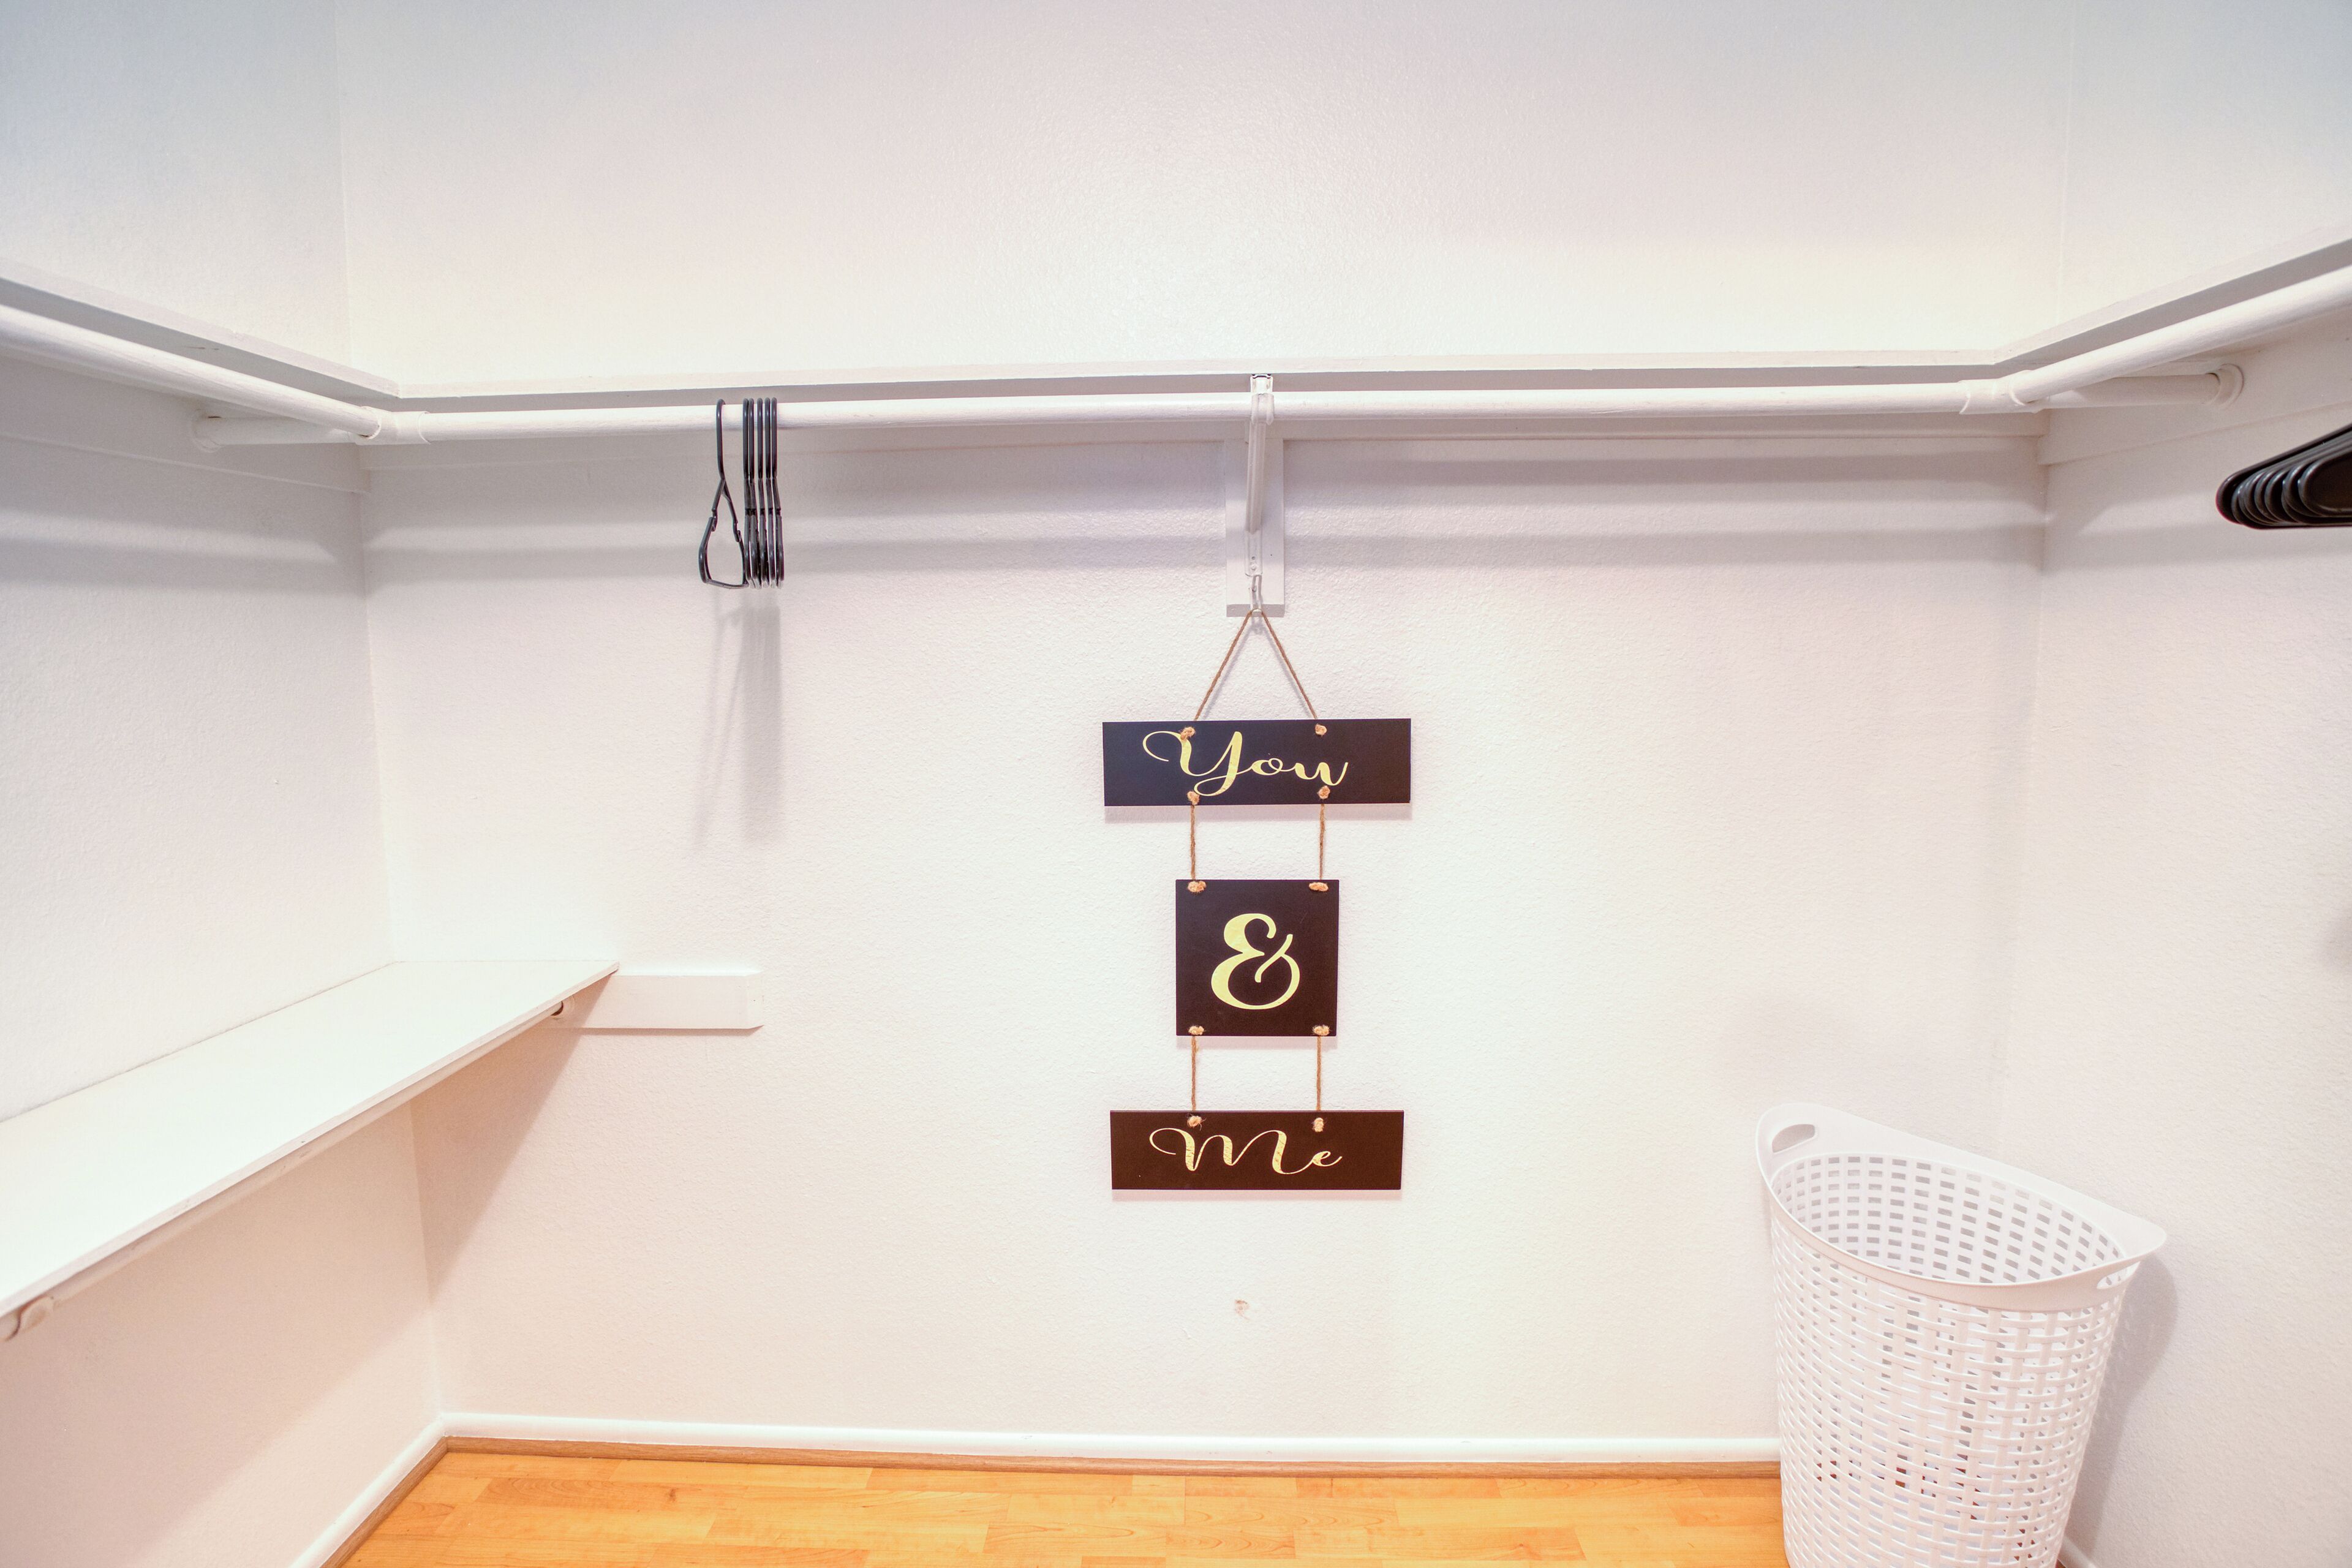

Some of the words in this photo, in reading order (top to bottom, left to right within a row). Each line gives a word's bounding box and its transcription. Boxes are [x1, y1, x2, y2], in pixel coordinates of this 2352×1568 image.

[1142, 730, 1349, 797] You
[1210, 913, 1301, 1011] &
[1149, 1127, 1343, 1175] Me
